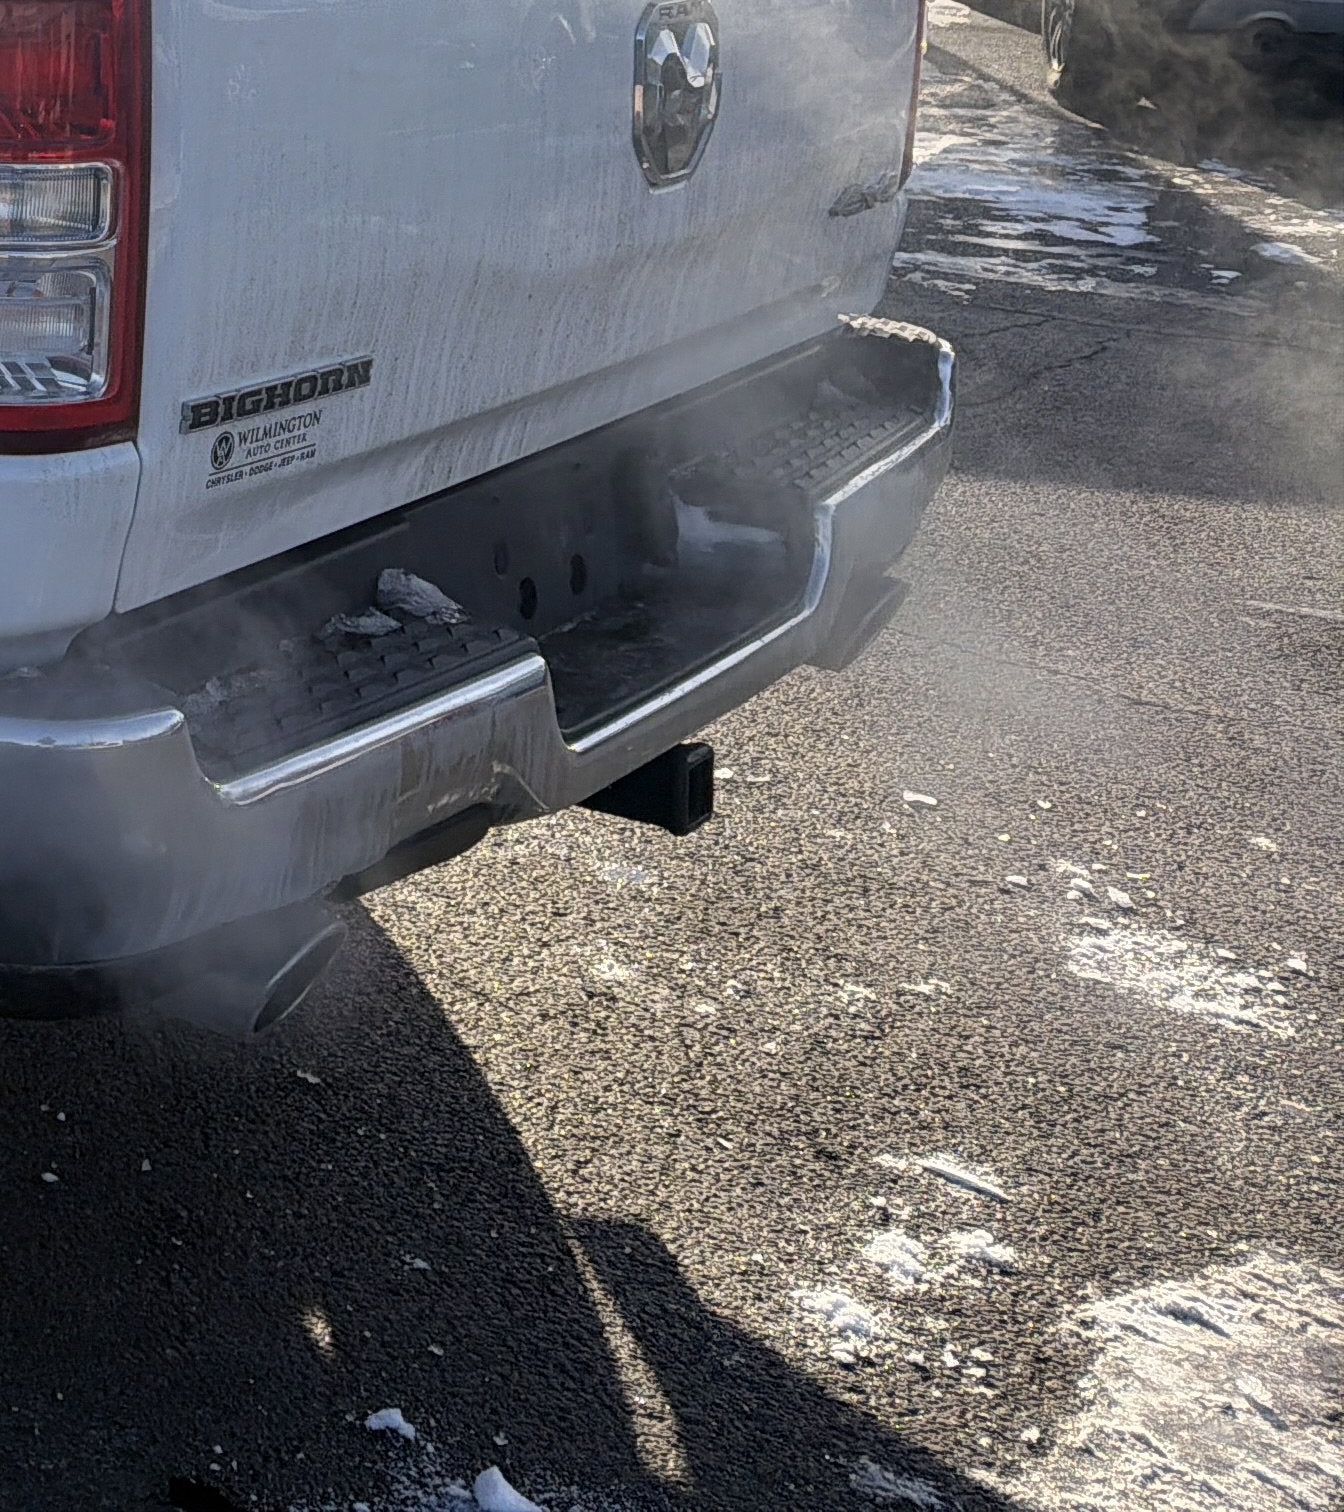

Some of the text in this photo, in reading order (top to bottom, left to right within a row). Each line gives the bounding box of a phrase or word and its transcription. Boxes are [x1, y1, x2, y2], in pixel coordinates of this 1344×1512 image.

[184, 356, 374, 431] BIGHORN
[237, 409, 322, 447] WILMINGTON
[245, 432, 308, 460] AUTO CENTER
[206, 448, 316, 489] CHRYSLER DODGE JEEP RAM
